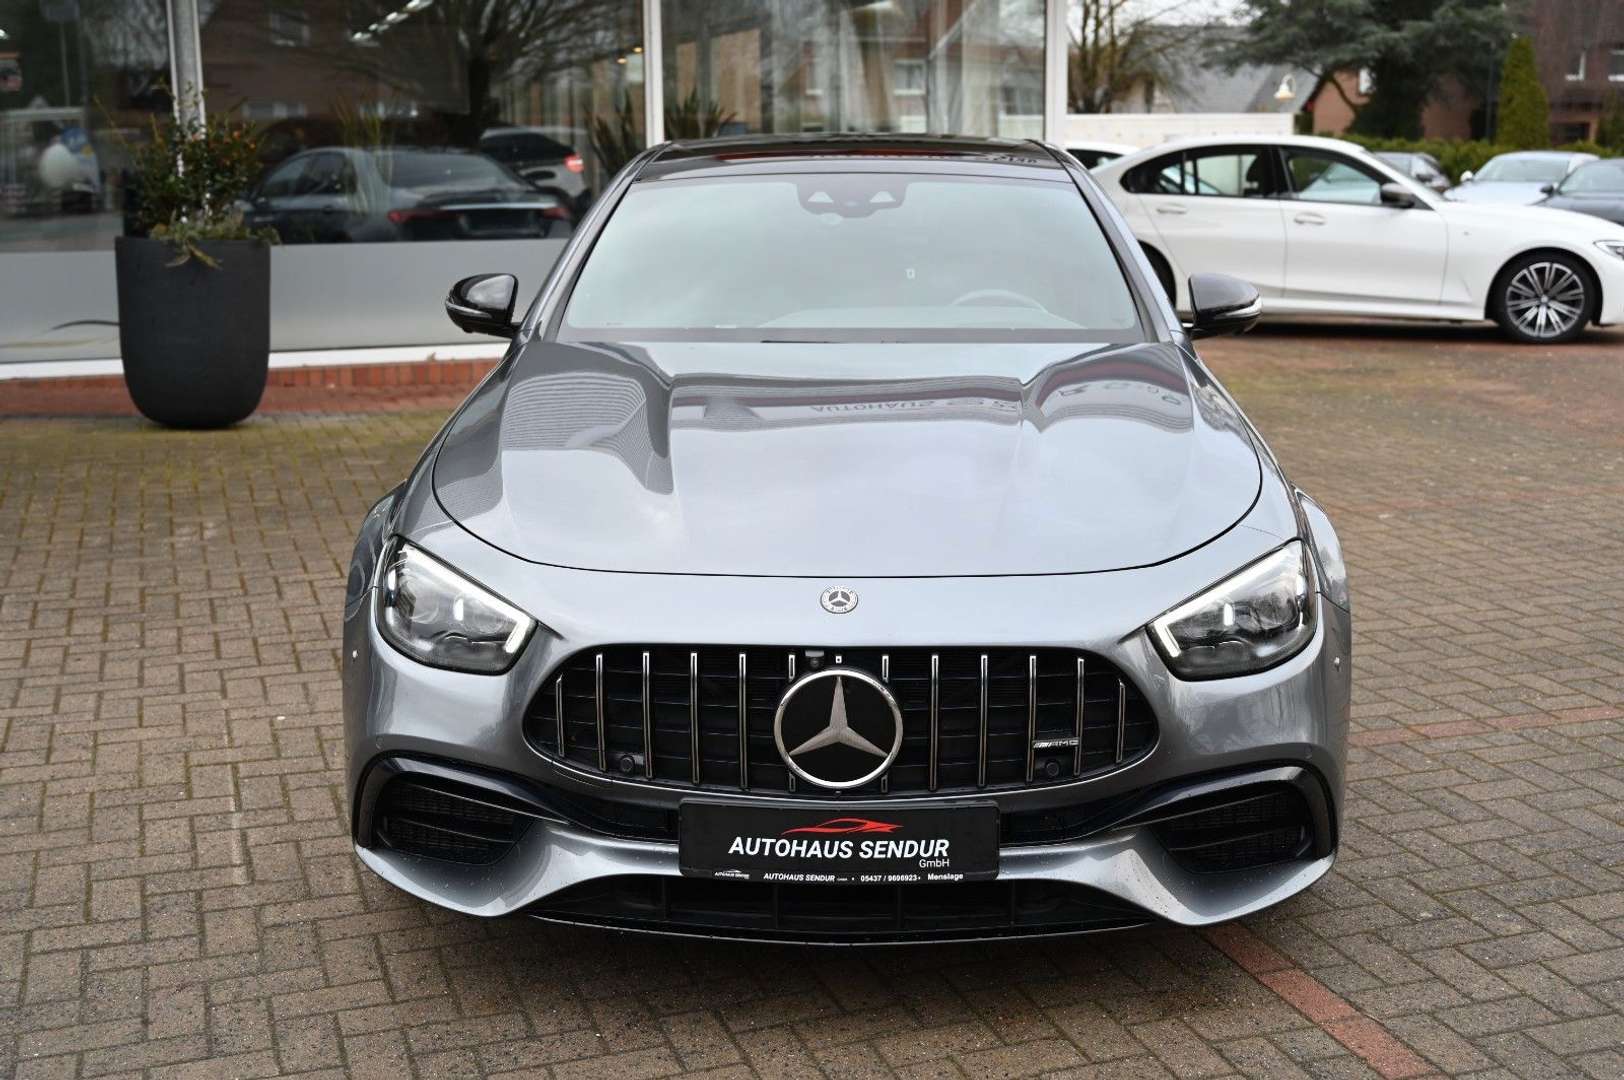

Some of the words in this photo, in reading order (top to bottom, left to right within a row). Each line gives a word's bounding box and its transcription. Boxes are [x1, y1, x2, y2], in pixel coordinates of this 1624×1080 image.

[728, 836, 854, 859] AUTOHAUS
[859, 839, 950, 859] SENDUR
[918, 858, 950, 868] GmbH
[763, 872, 804, 882] AUTOHAUS
[805, 874, 836, 883] SENDUR
